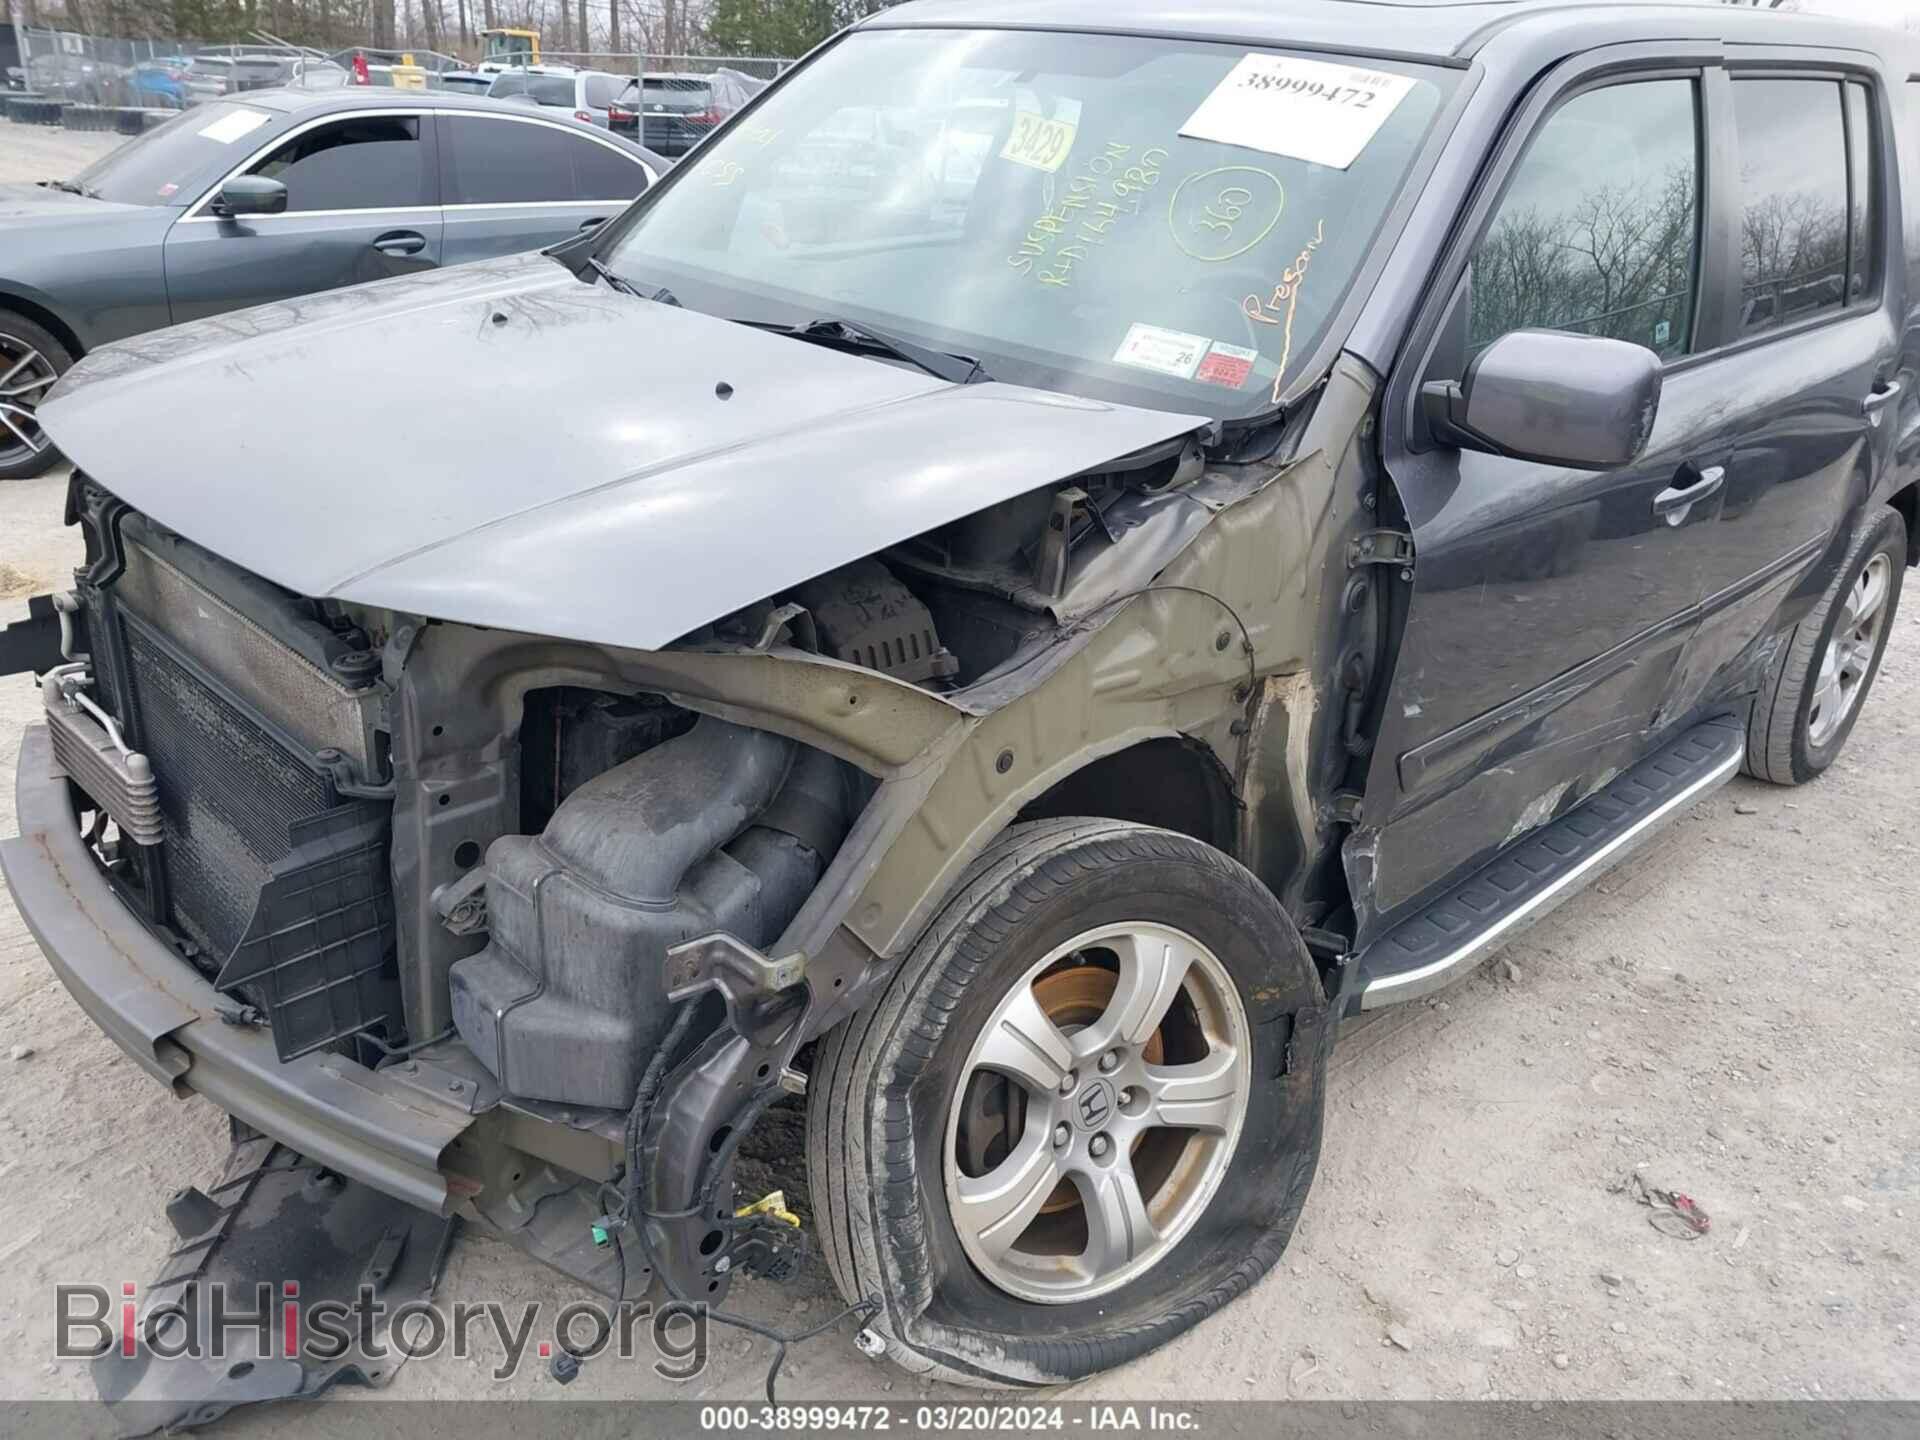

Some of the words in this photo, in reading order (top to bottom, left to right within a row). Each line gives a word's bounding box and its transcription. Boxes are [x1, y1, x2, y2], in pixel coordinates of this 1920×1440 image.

[1237, 72, 1376, 109] 38999472
[1010, 115, 1065, 164] 3429
[1007, 141, 1131, 275] SUSPENSION
[1199, 187, 1252, 241] 360
[1175, 351, 1194, 365] 26
